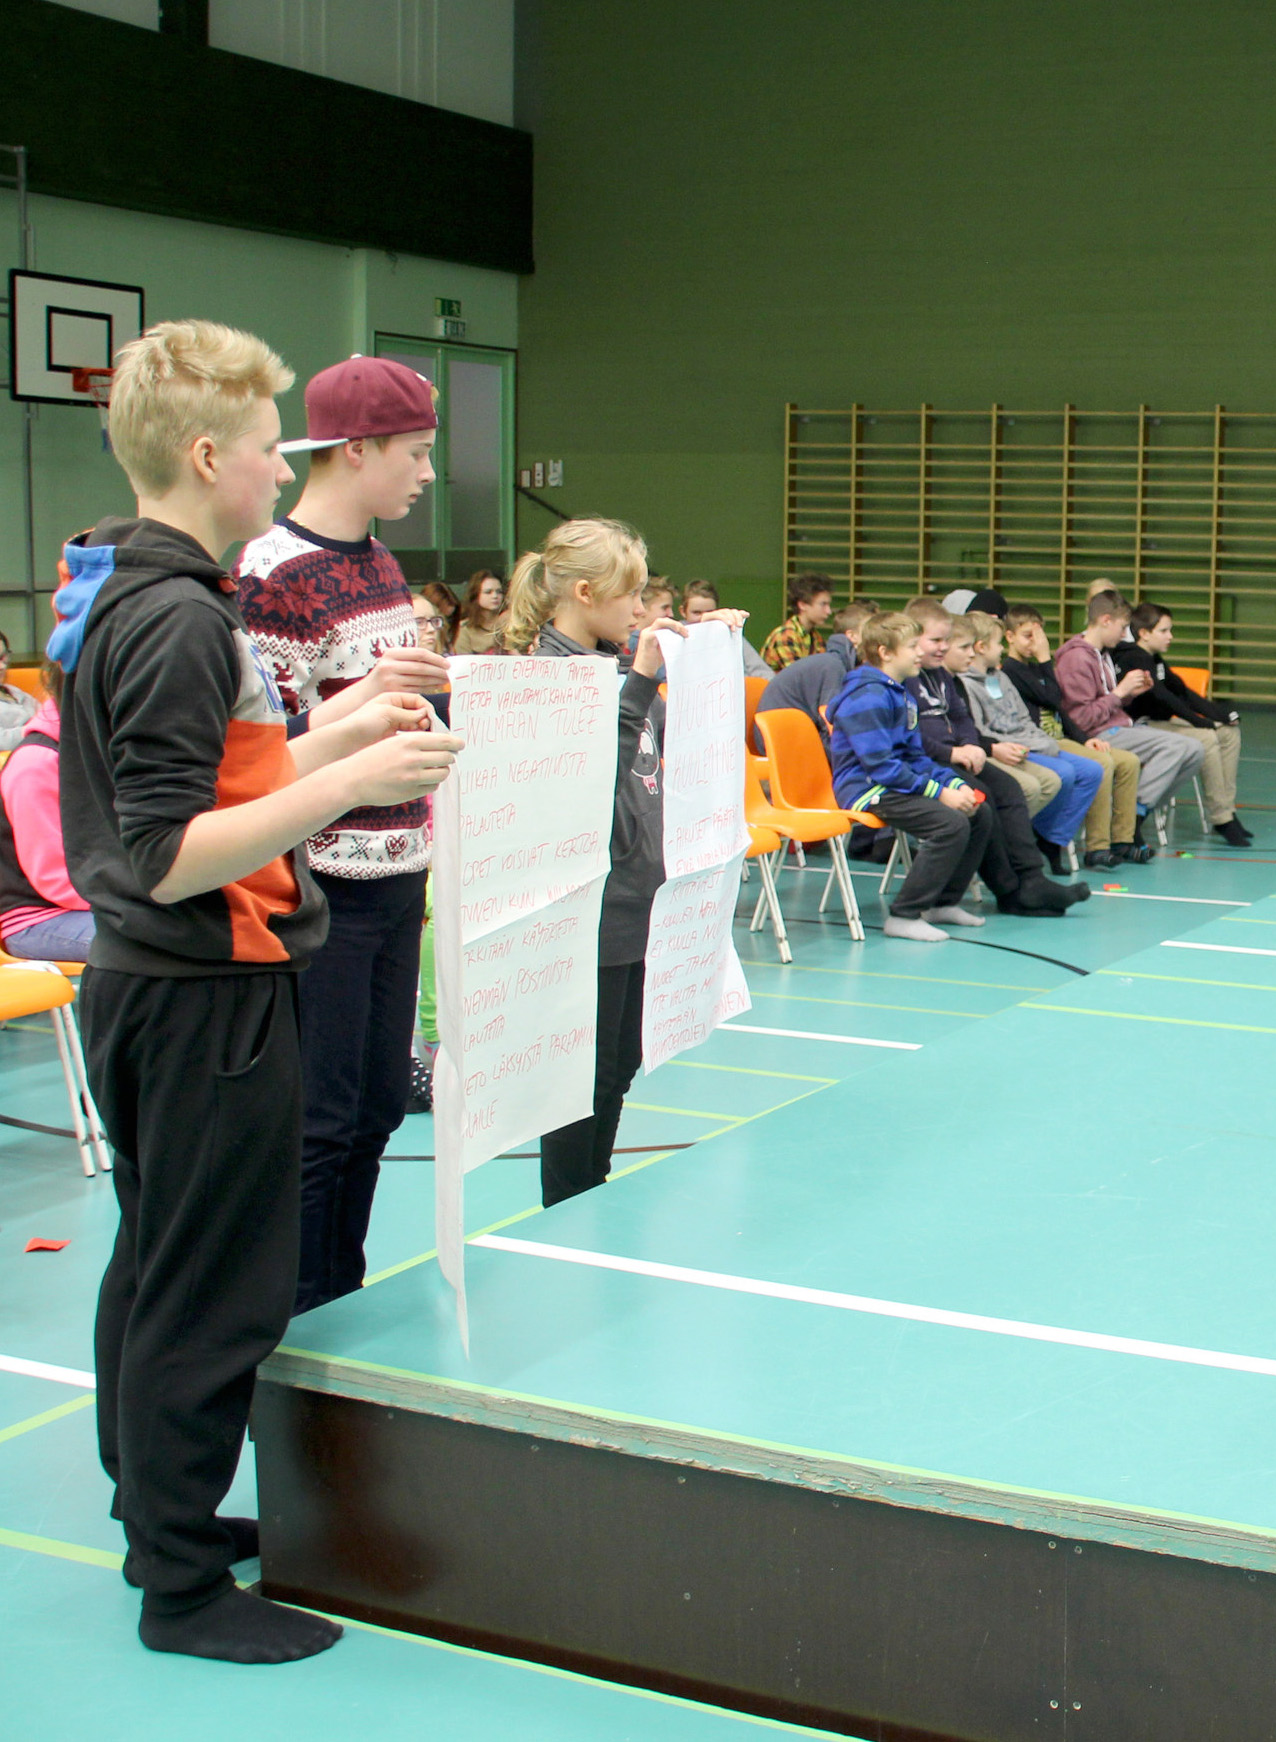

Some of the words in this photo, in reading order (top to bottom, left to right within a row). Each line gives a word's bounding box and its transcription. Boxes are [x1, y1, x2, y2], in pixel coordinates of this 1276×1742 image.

[549, 704, 604, 736] TULEE
[462, 855, 497, 886] OPET
[501, 843, 550, 872] VOISIVAT
[463, 1014, 506, 1053] LAUTETTA
